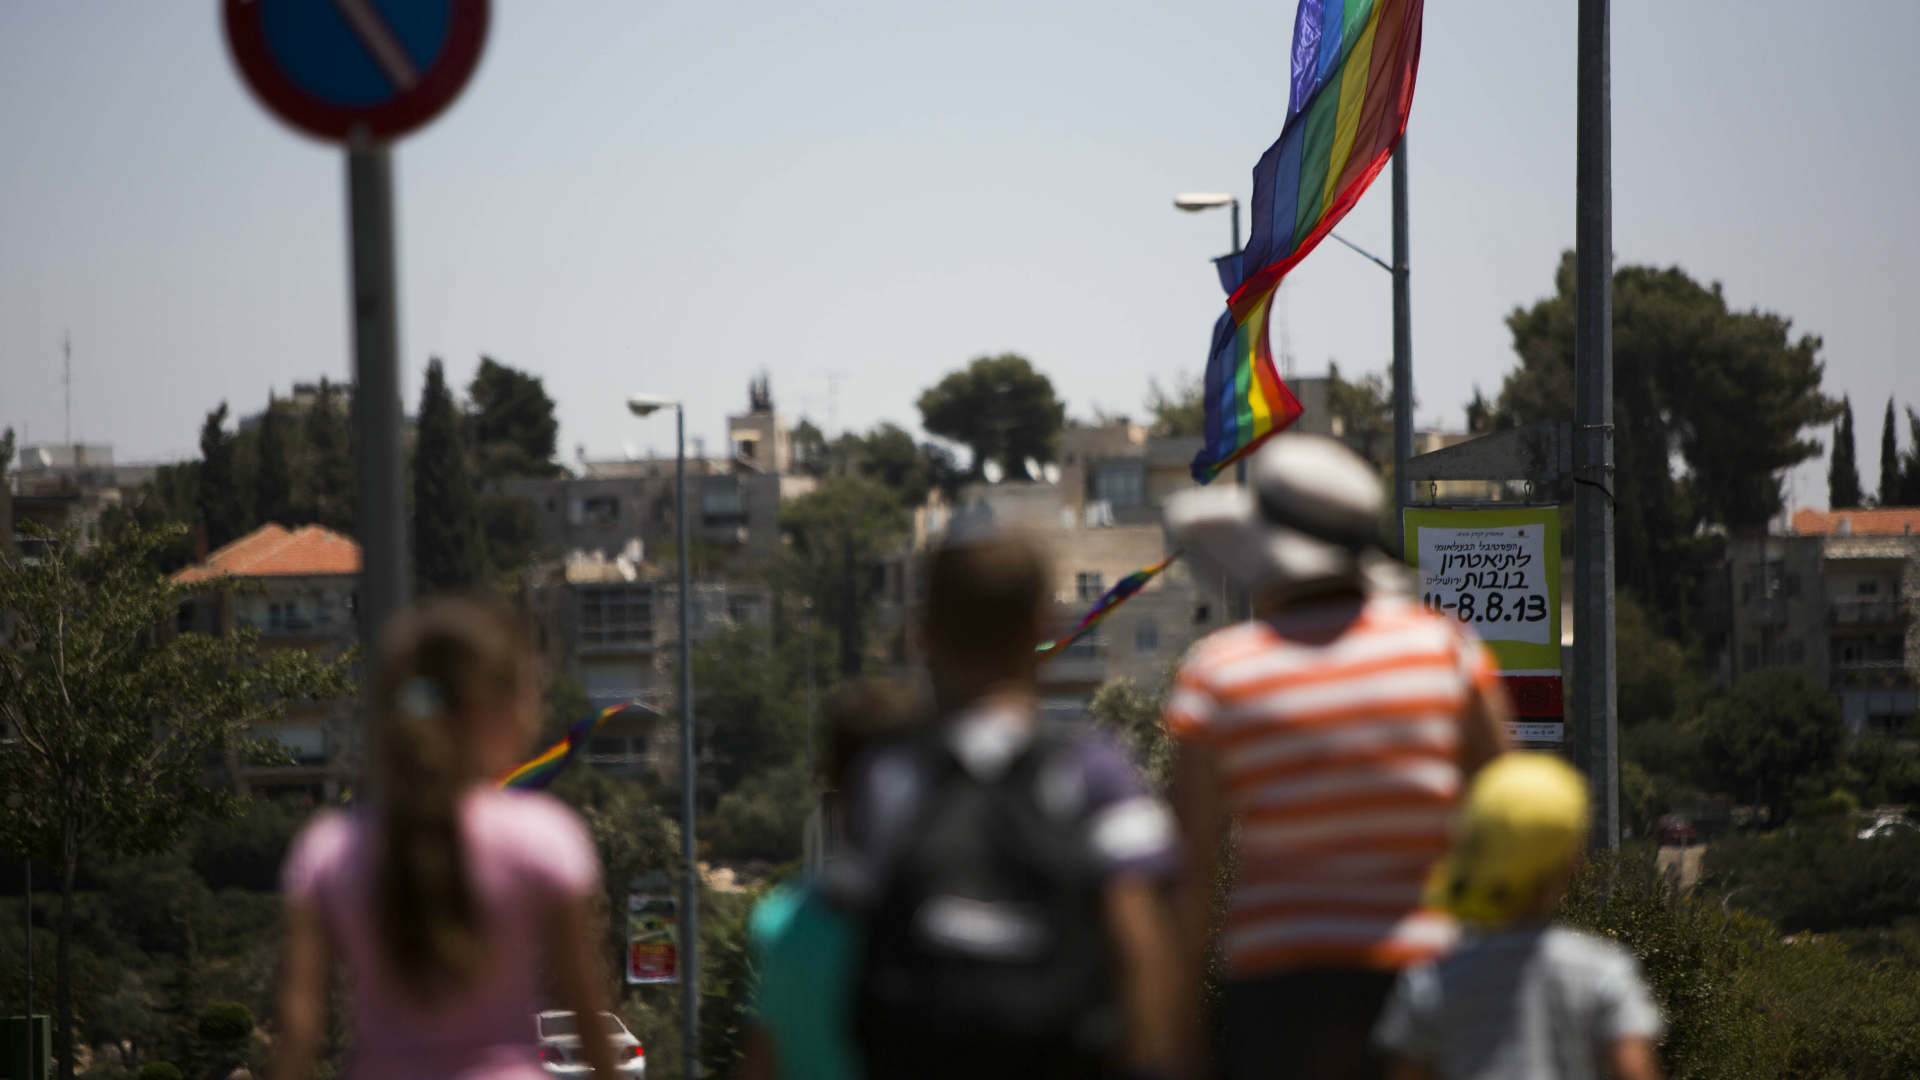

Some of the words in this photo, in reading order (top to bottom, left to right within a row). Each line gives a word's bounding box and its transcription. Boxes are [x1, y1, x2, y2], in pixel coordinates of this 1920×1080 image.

[1478, 541, 1518, 552] הפסטיבל
[1440, 545, 1532, 576] לתיאטרון
[1425, 574, 1462, 586] ירושלים
[1455, 571, 1529, 592] בובות
